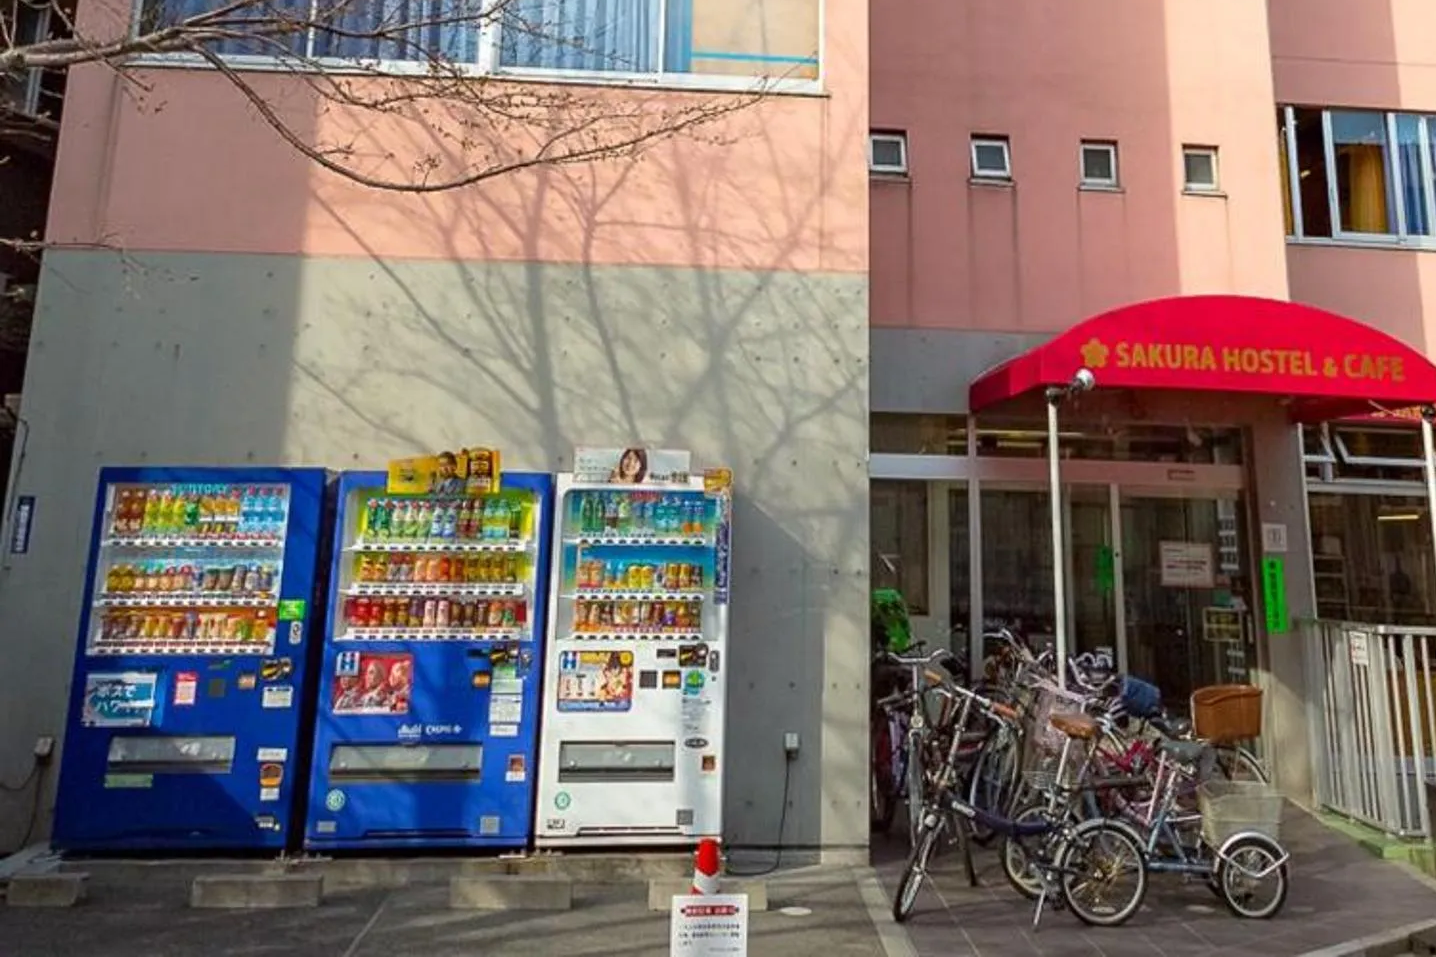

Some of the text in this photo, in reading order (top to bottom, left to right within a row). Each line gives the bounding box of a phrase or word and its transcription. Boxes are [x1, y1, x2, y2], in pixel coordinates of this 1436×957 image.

[1116, 342, 1406, 382] SAKURA HOSTEL & CAFE
